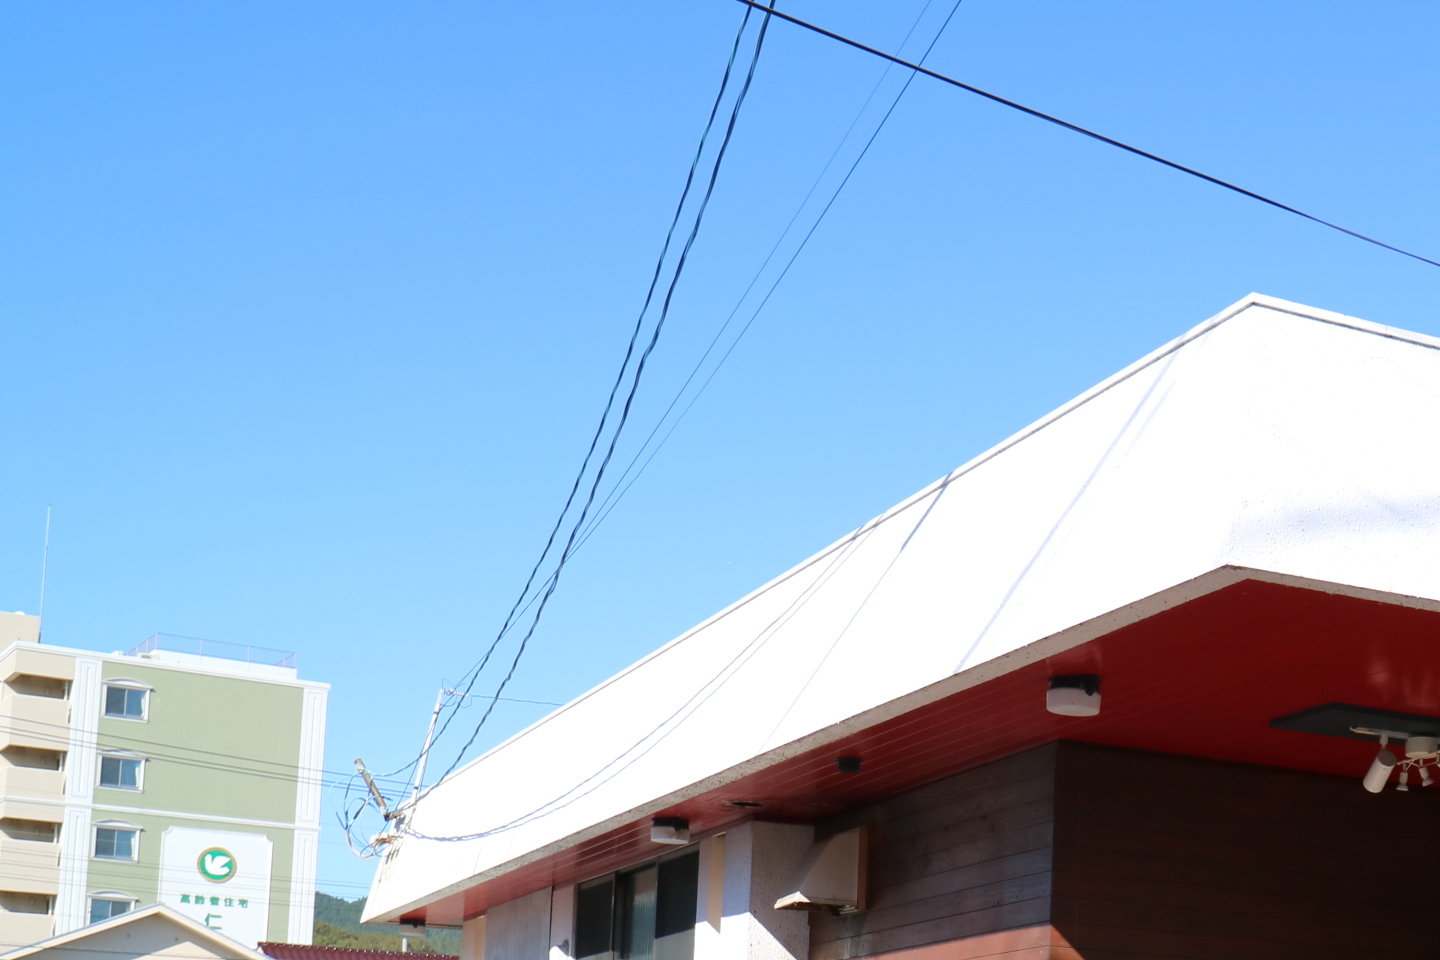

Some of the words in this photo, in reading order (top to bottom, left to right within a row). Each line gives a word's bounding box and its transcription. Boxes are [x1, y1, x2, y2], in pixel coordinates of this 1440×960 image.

[180, 893, 248, 908] 高齢者住宅
